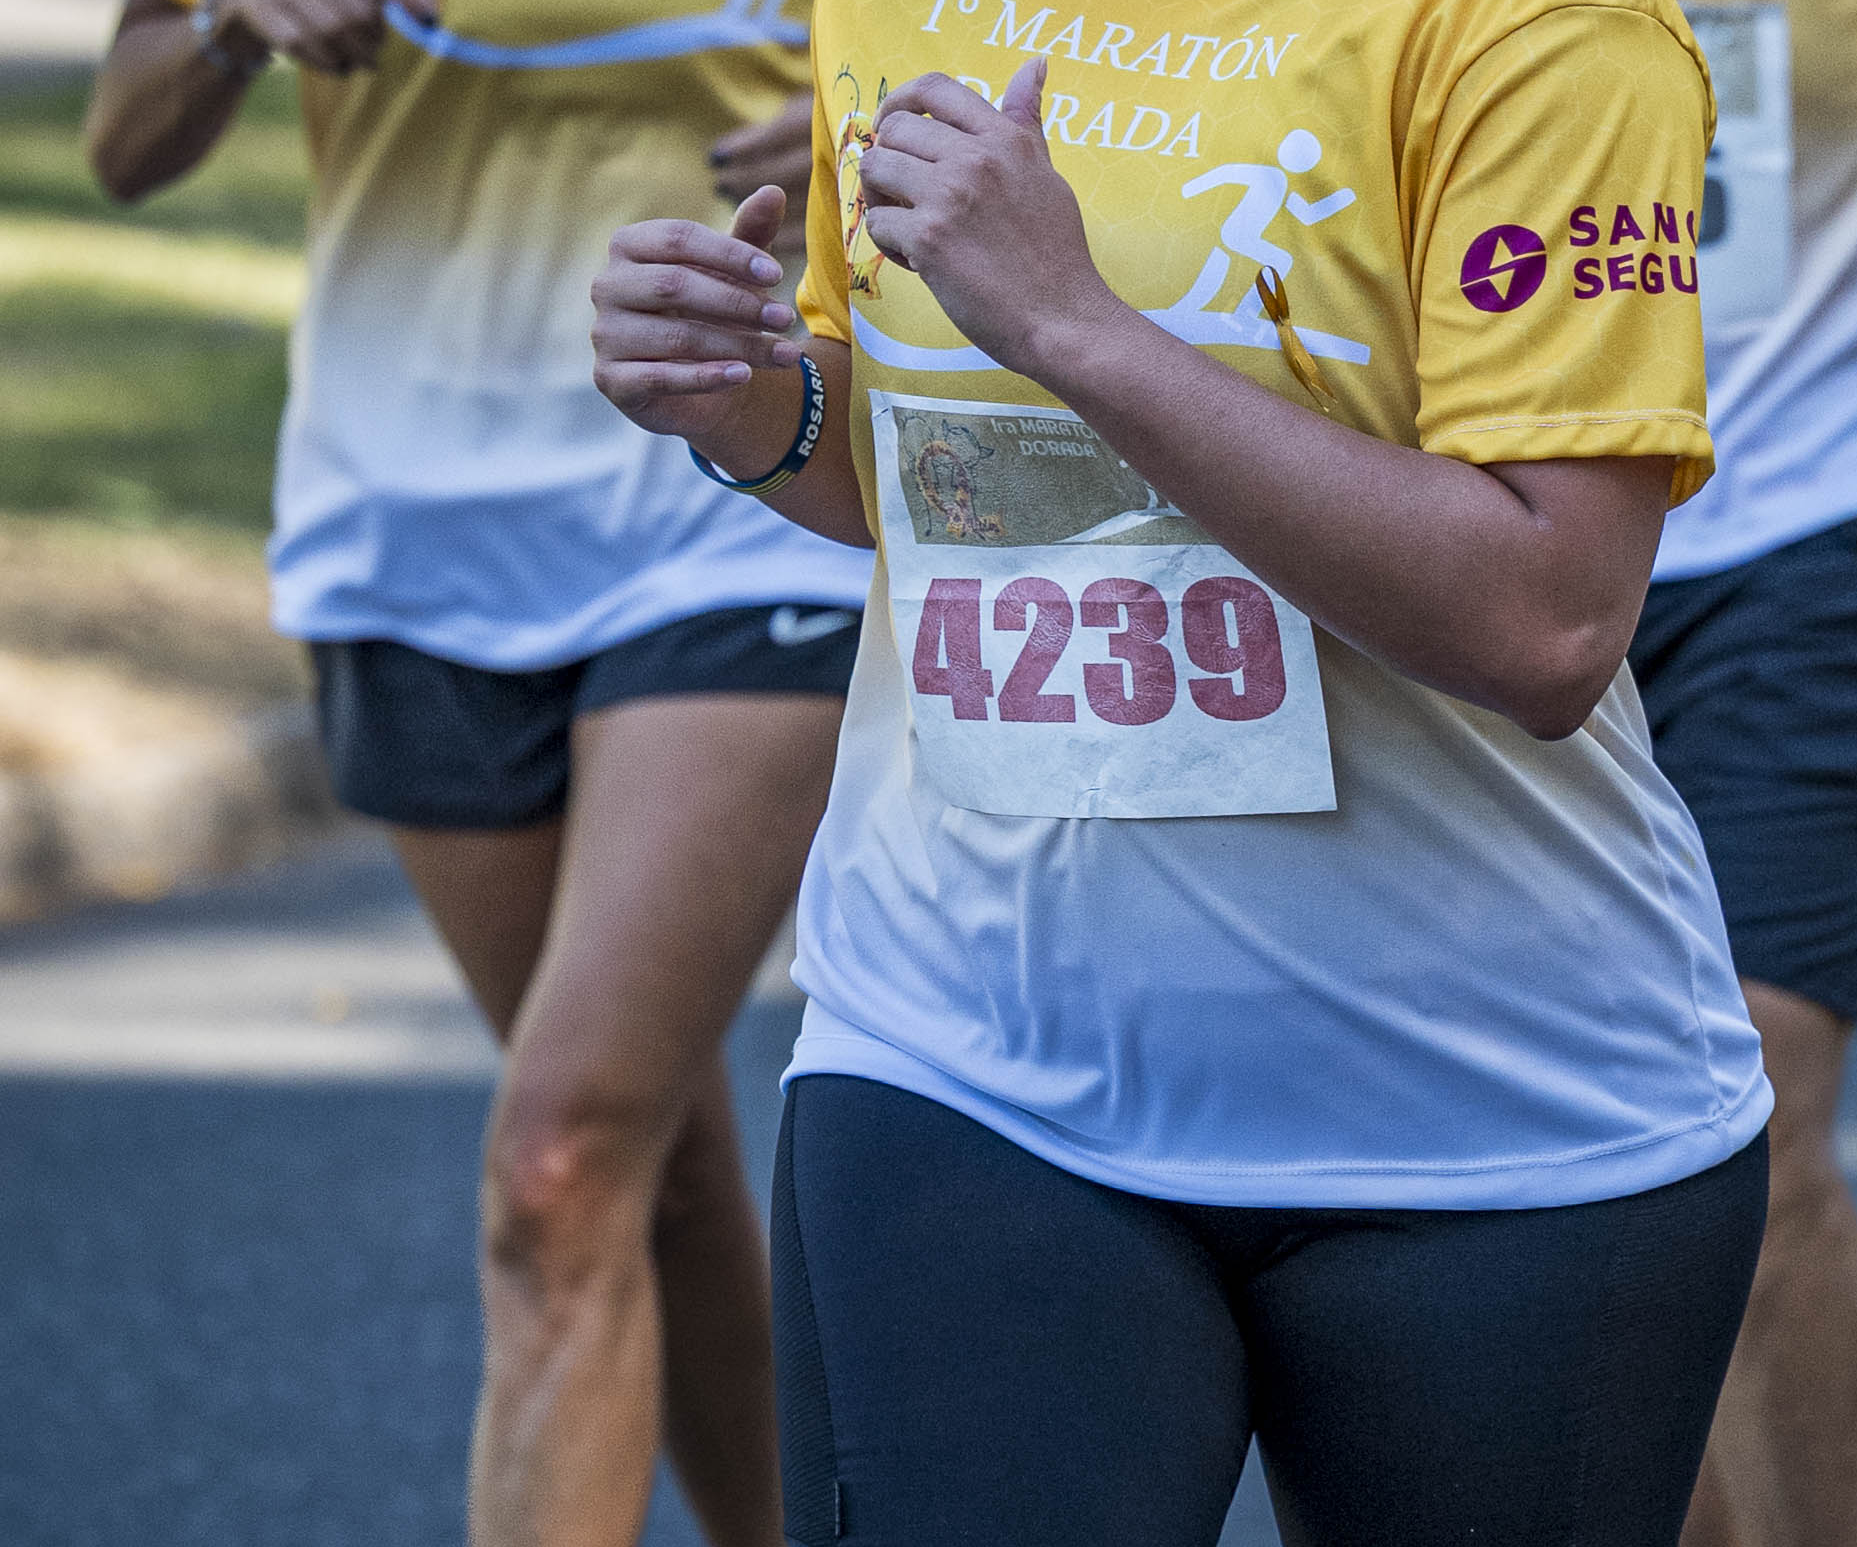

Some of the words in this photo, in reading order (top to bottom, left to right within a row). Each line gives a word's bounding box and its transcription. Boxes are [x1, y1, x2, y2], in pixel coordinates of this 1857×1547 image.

[797, 356, 825, 457] ROSARIO
[1018, 418, 1100, 441] MARATO
[1018, 440, 1098, 459] DORADA
[912, 576, 1287, 726] 4239
